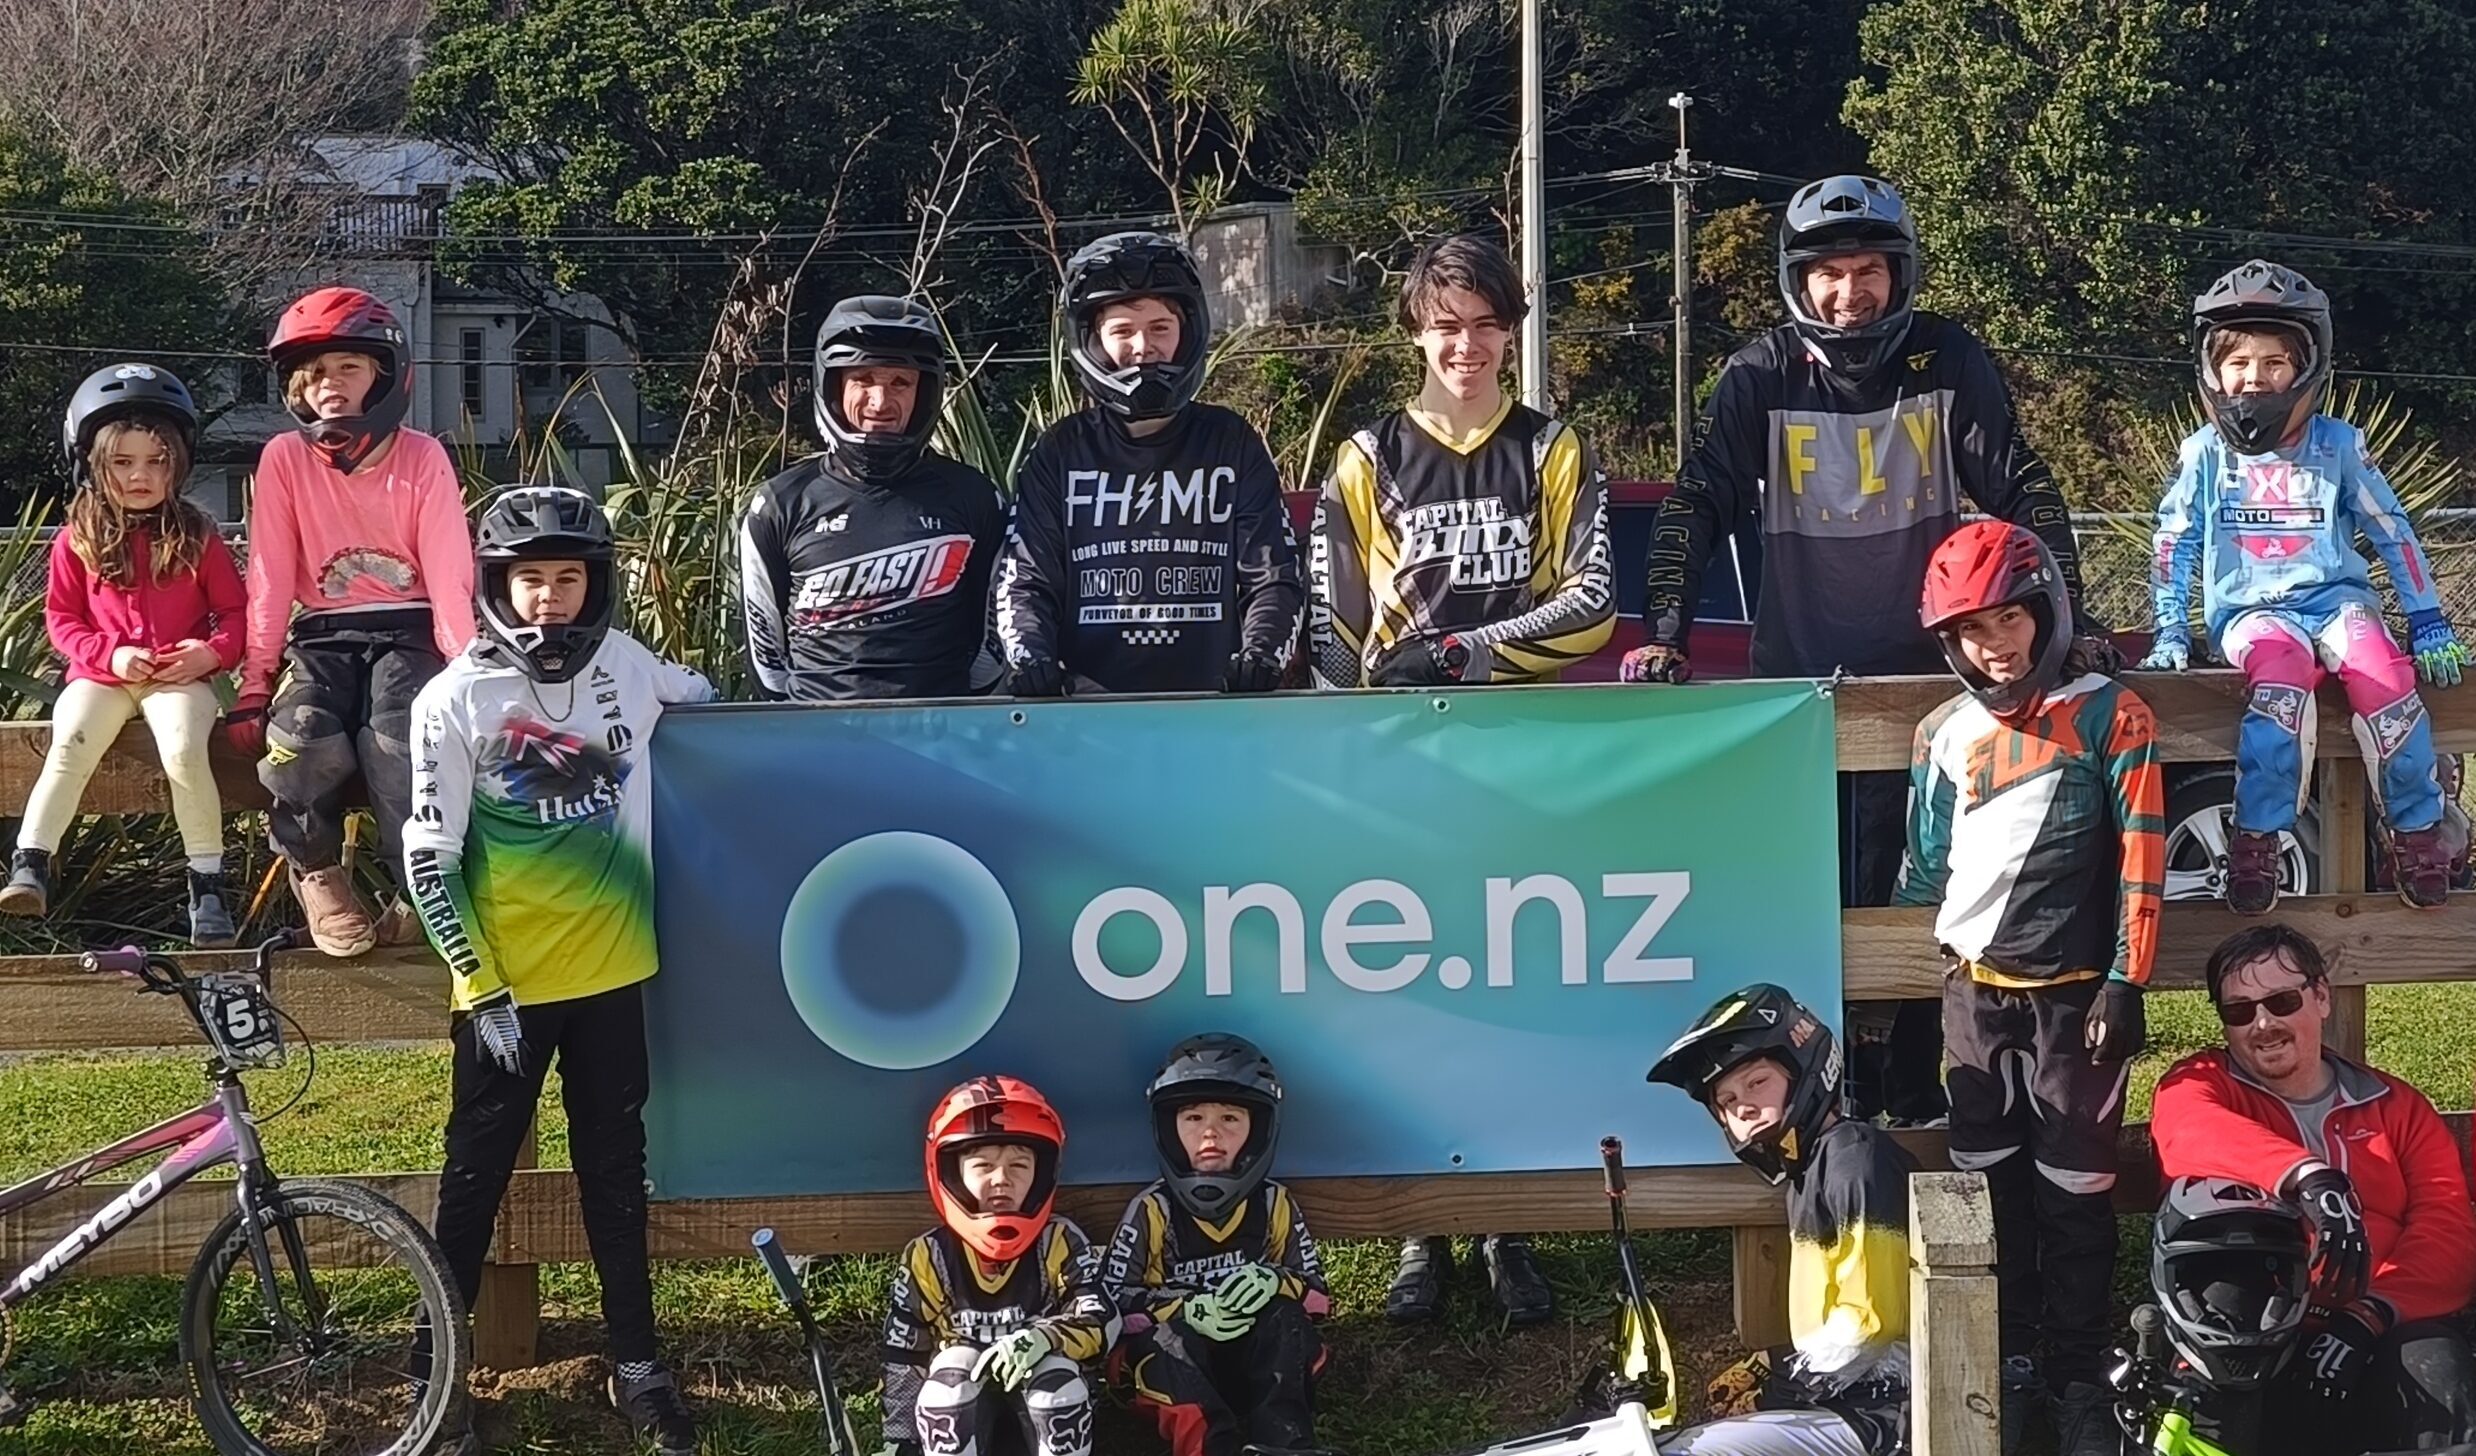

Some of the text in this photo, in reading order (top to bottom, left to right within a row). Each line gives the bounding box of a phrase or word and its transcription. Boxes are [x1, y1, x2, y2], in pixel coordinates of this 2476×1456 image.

[1786, 407, 1938, 495] FLY
[1402, 498, 1505, 537] CAPITAL
[2223, 509, 2269, 523] MOTO
[1072, 543, 1098, 562] LONG
[1102, 540, 1127, 555] LIVE
[1131, 538, 1169, 553] SPEED
[1173, 538, 1199, 553] AND
[1451, 549, 1531, 586] CLUB
[1080, 565, 1222, 598] MOTO CREW
[1083, 607, 1133, 621] PURVEYOR
[1139, 607, 1152, 619] OF
[410, 850, 481, 978] AUSTRALIA
[1072, 871, 1694, 1000] one.nz
[226, 999, 255, 1039] 5
[19, 1170, 163, 1292] MEYBO
[1174, 1250, 1246, 1277] CAPITAL
[951, 1305, 1025, 1327] CAPITAL
